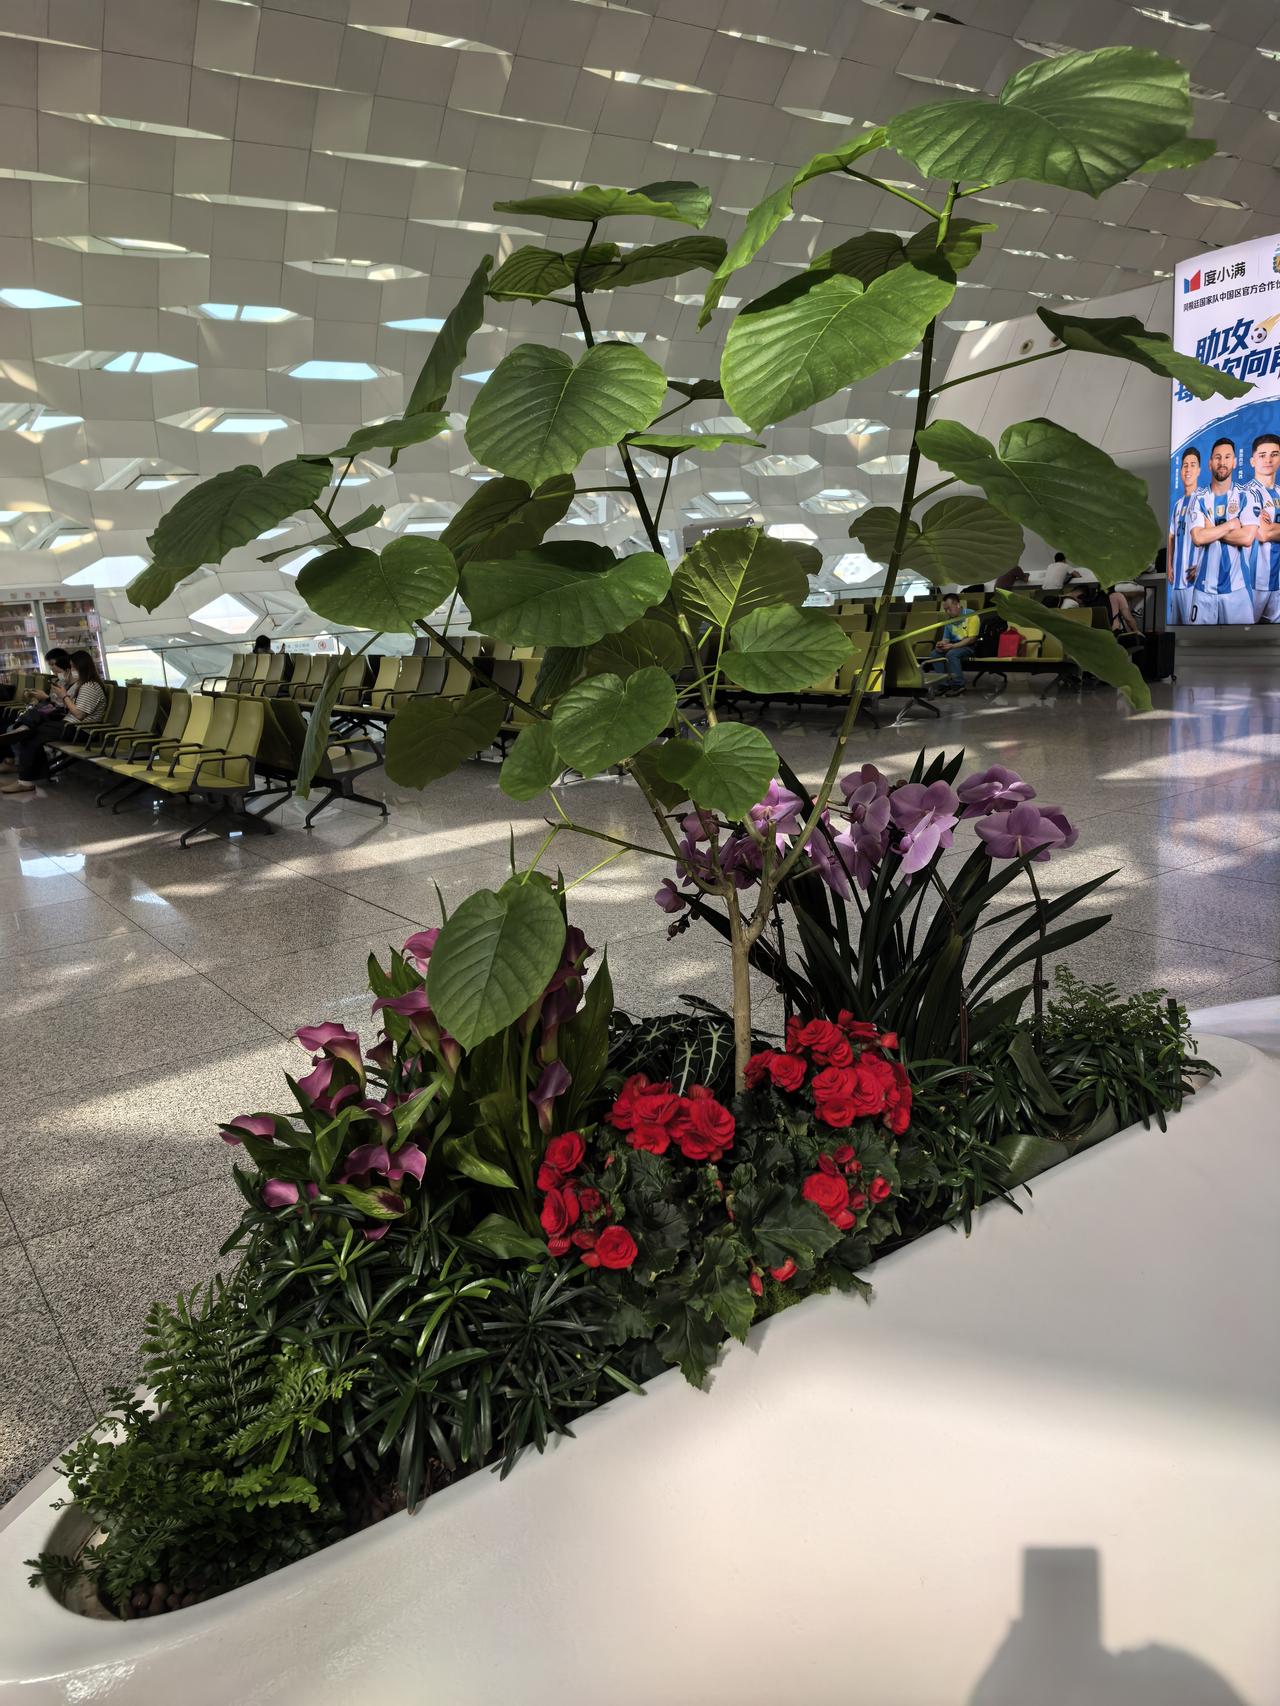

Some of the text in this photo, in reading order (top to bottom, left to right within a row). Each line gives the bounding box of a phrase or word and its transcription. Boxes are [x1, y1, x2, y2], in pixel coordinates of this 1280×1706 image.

[1204, 262, 1246, 287] 度小满
[1195, 318, 1255, 365] 助攻
